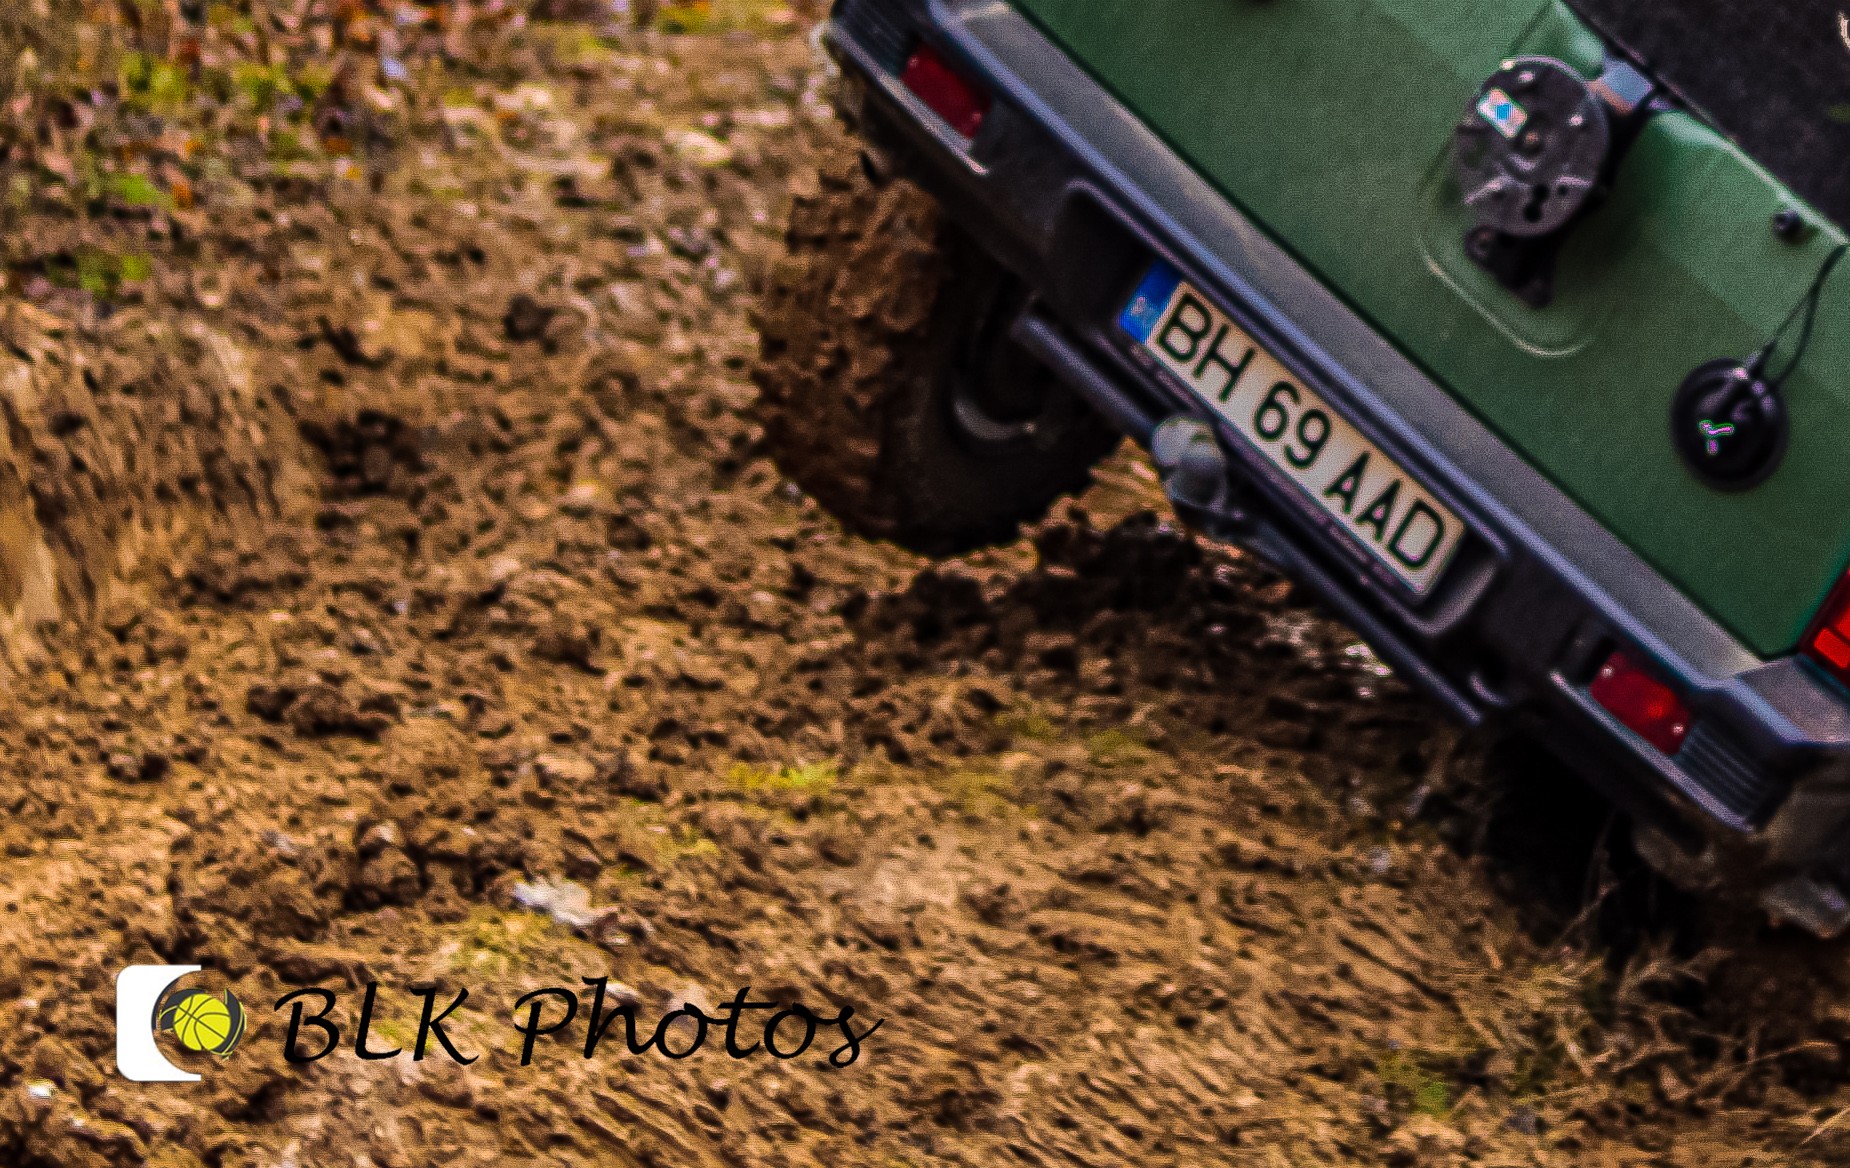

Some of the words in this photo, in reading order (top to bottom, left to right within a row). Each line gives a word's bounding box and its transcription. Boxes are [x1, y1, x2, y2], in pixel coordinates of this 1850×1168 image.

[1156, 291, 1256, 403] BH
[1253, 380, 1332, 469] 69
[1323, 450, 1446, 570] AAD
